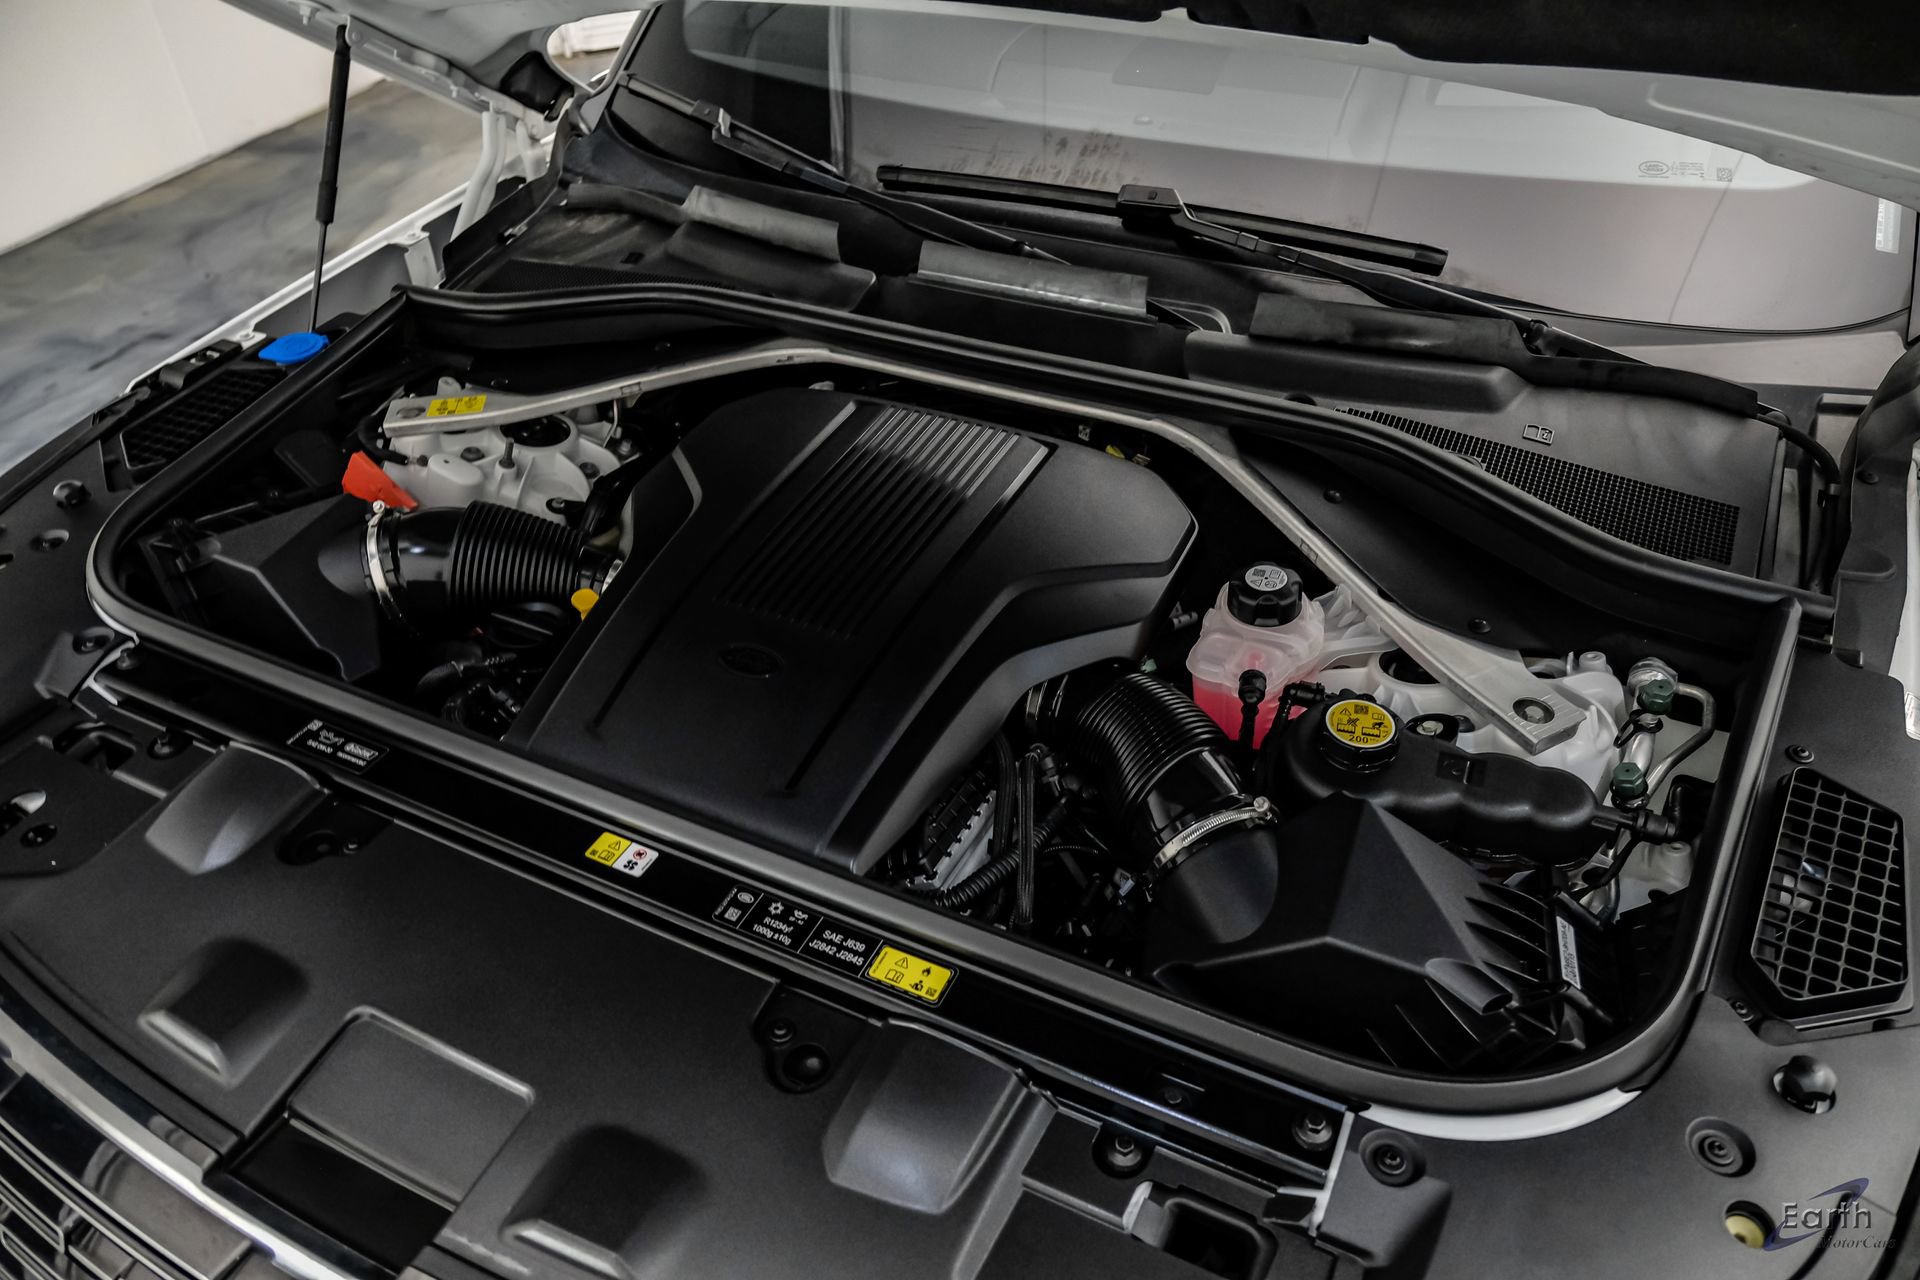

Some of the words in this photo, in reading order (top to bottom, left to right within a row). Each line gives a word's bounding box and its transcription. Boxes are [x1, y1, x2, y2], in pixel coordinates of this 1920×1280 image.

[1348, 734, 1369, 744] 200
[753, 923, 774, 938] 1000g
[763, 916, 794, 933] R1234yf
[822, 930, 844, 944] SAE
[842, 938, 866, 952] J639
[808, 939, 837, 956] J2842
[835, 950, 865, 966] J2845
